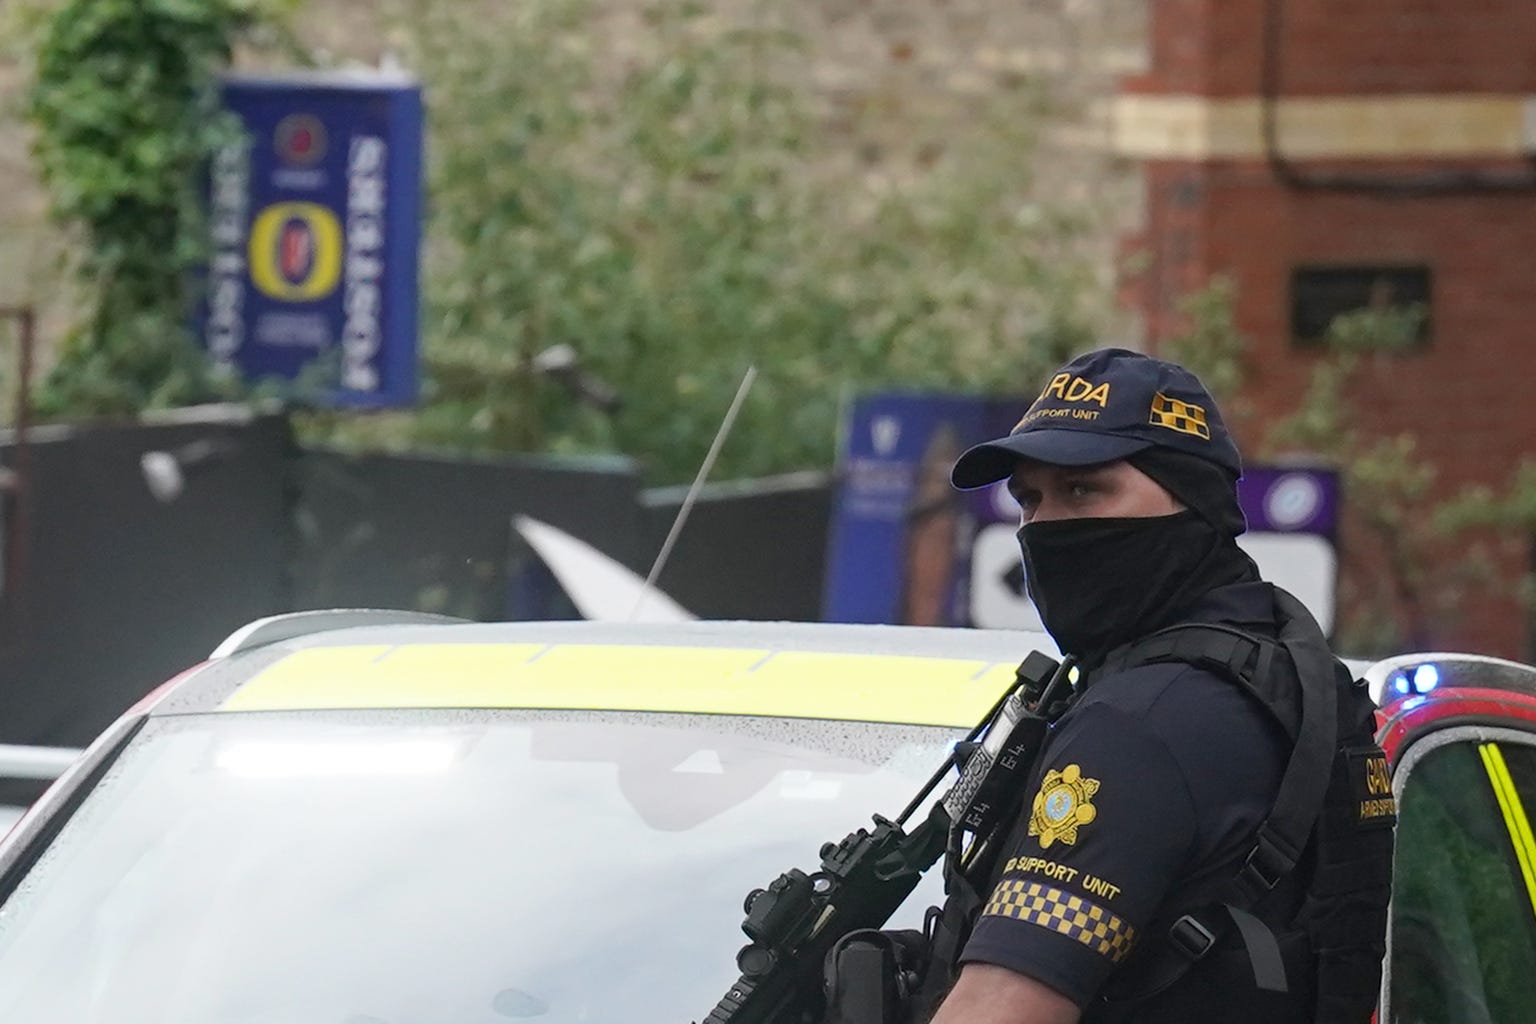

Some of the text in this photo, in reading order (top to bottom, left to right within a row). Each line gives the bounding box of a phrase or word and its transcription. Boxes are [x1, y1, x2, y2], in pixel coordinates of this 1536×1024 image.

[1072, 409, 1101, 421] UNIT
[1016, 856, 1079, 883] SUPPORT
[1082, 874, 1121, 900] UNIT
